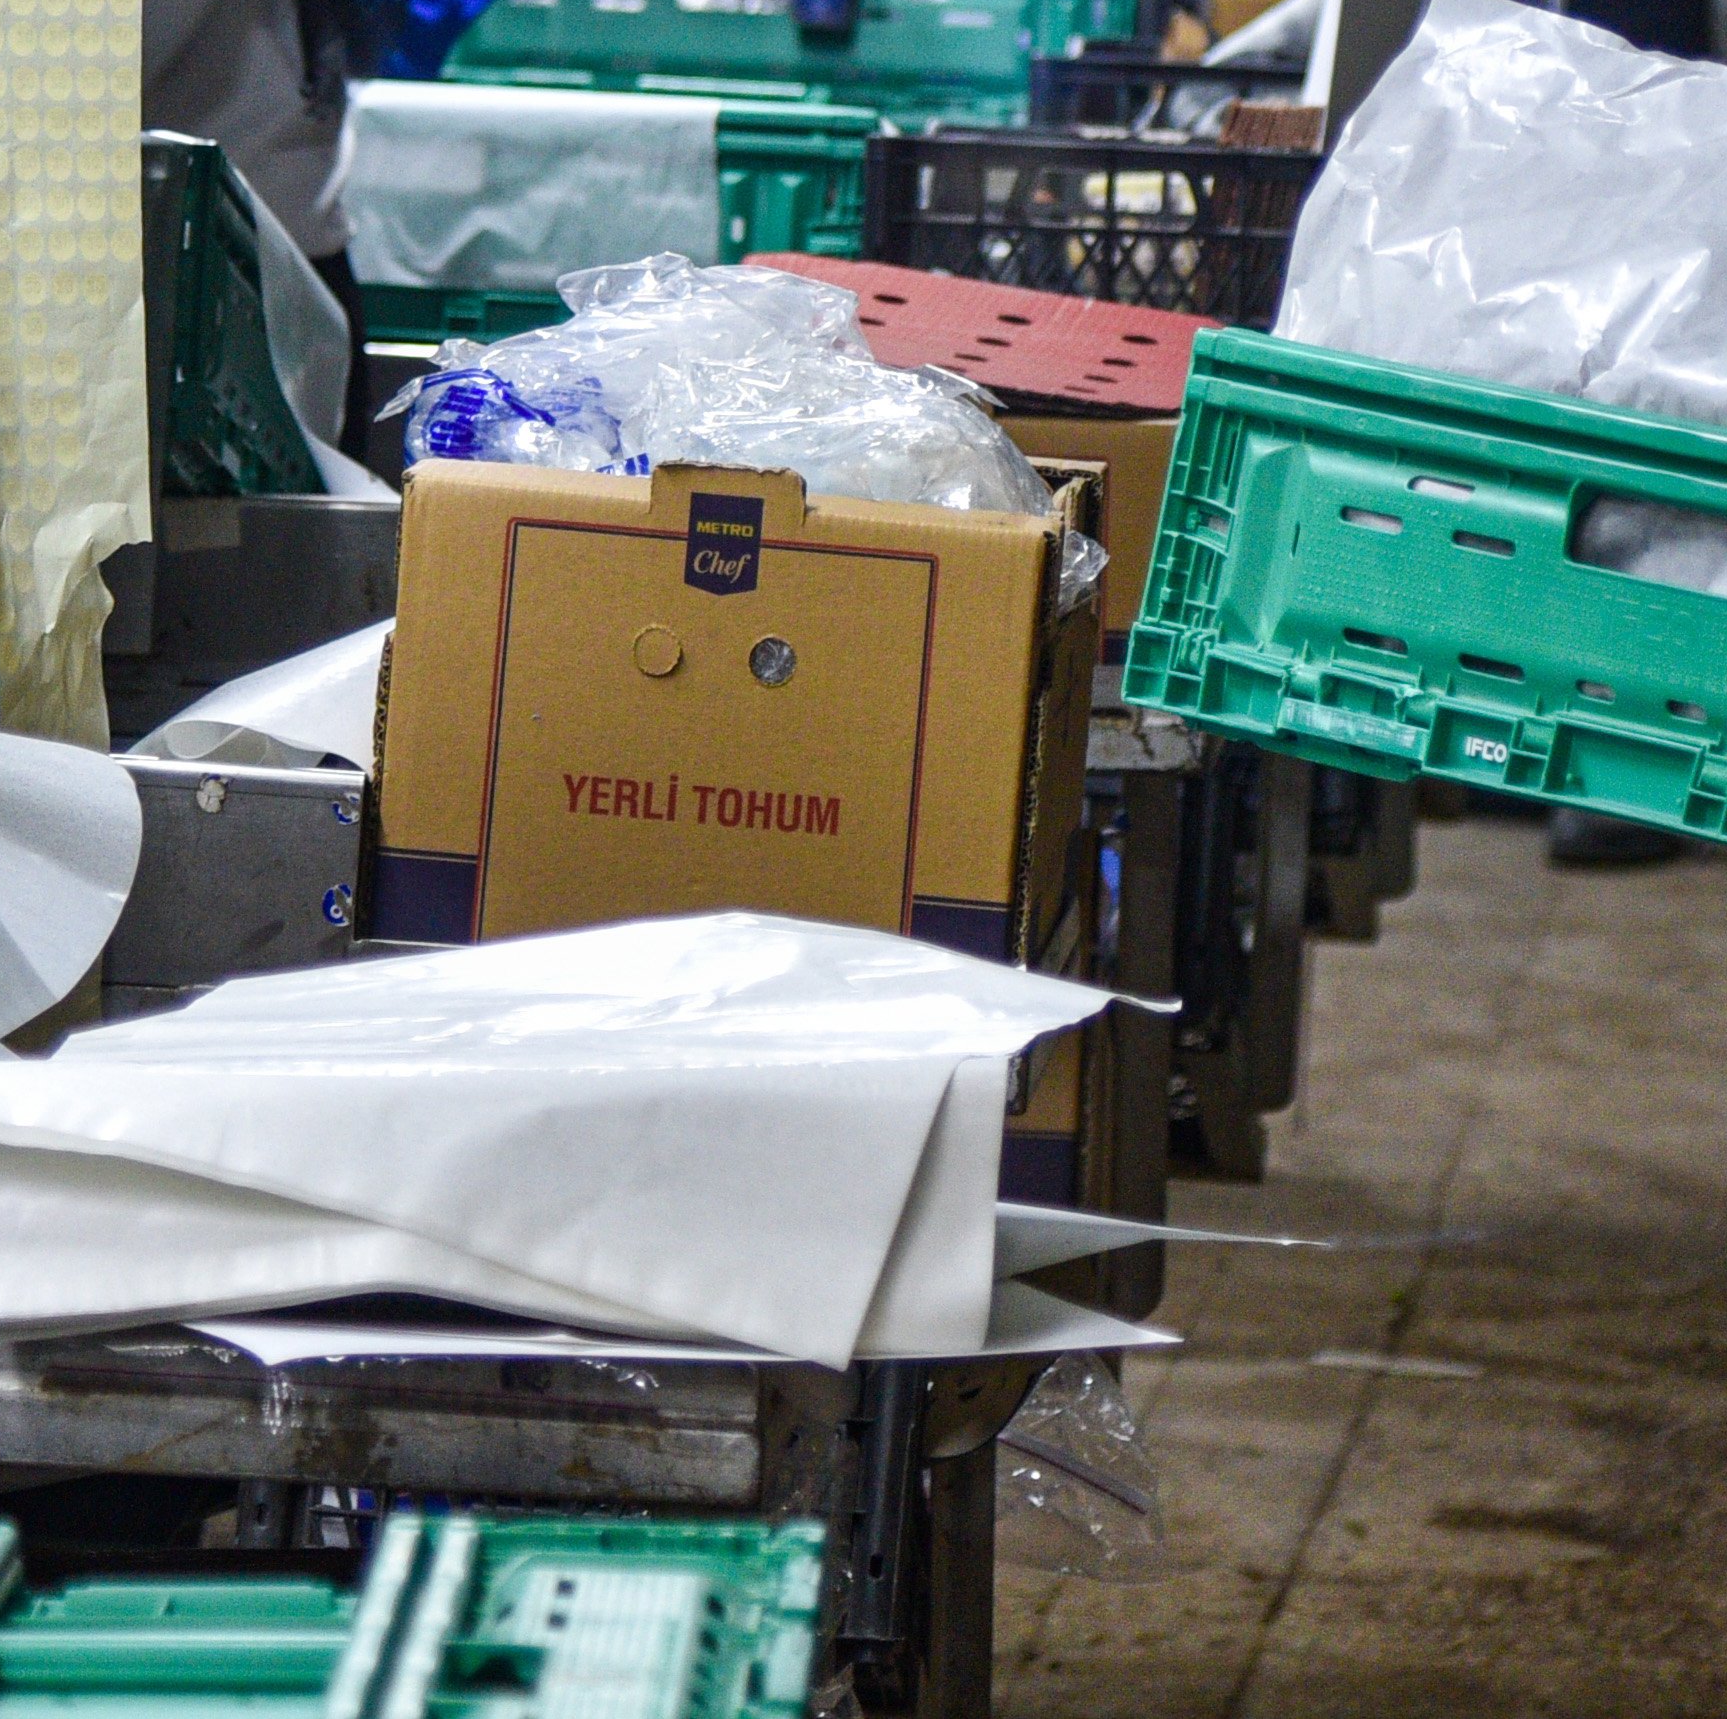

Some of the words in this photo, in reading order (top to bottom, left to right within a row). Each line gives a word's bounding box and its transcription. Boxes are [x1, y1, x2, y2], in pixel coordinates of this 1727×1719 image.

[696, 521, 755, 538] METRO
[693, 549, 752, 584] Chef
[1464, 736, 1508, 764] IFCO
[562, 773, 680, 822] YERLİ
[692, 785, 842, 837] TOHUM
